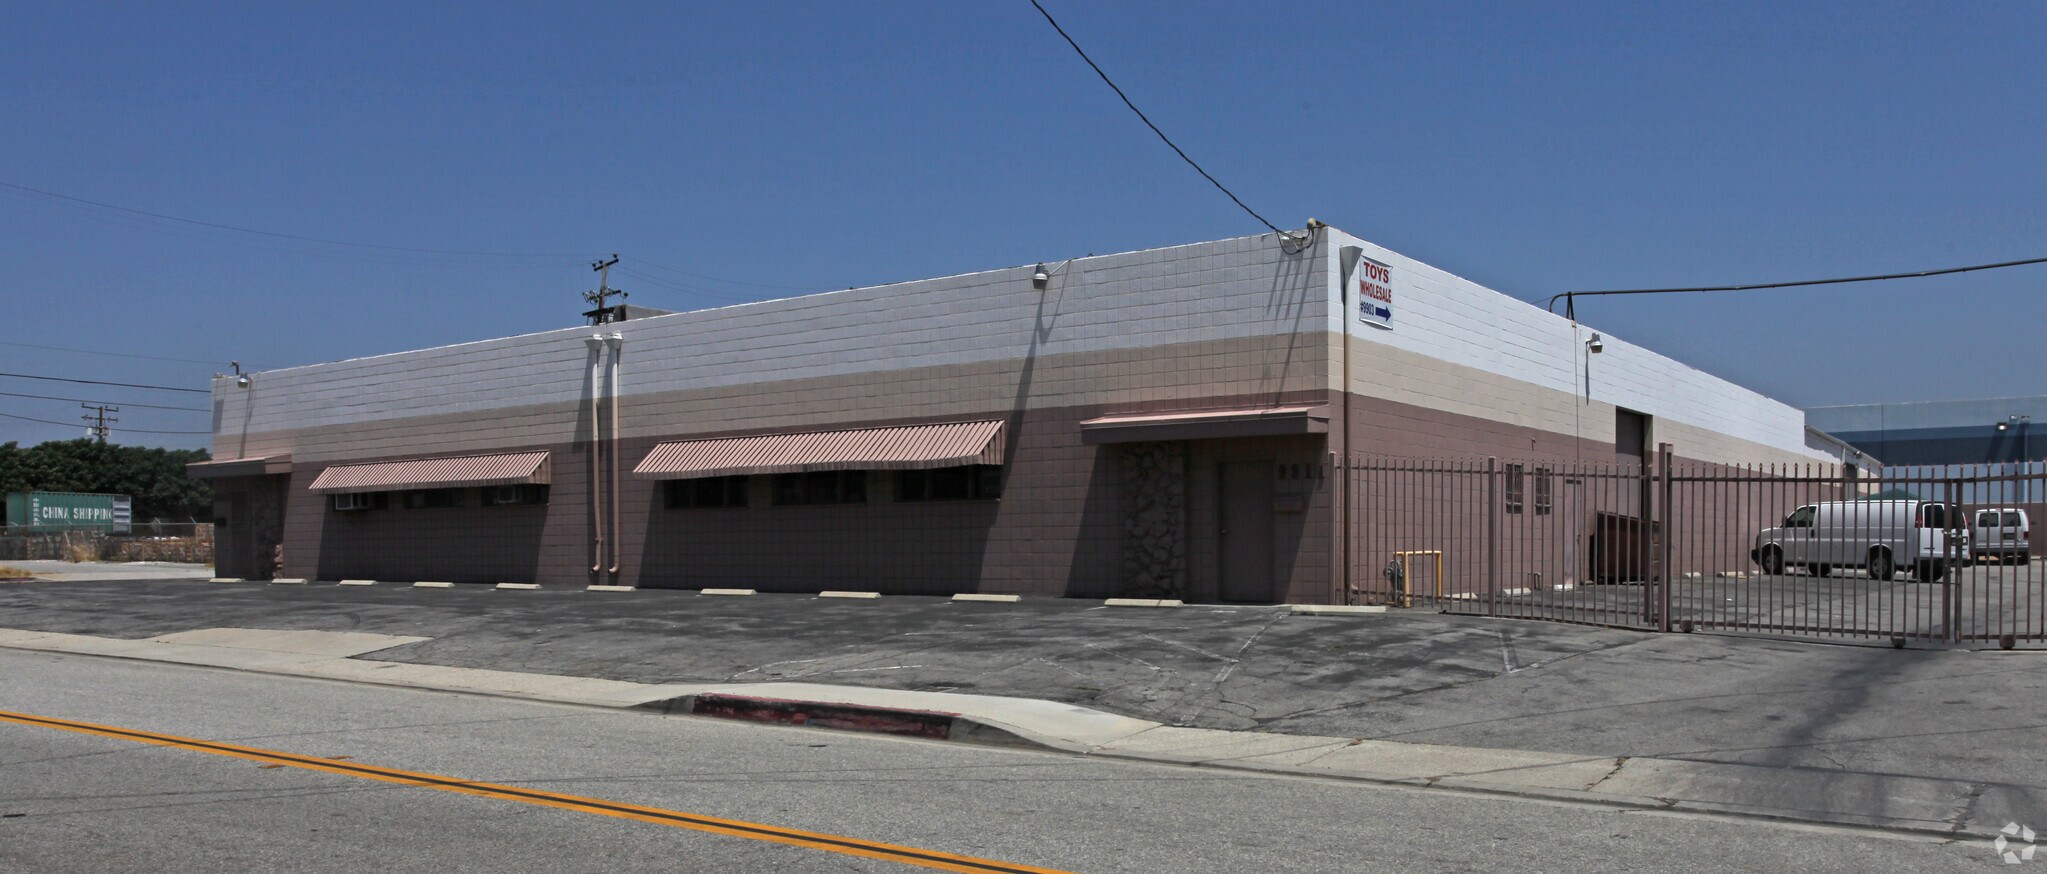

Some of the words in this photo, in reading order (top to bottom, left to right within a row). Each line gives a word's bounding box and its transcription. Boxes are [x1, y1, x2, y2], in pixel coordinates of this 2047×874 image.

[1363, 261, 1389, 284] TOYS
[1360, 280, 1392, 304] WHOLESALE
[1360, 301, 1375, 316] #9903
[42, 506, 70, 519] CHINA
